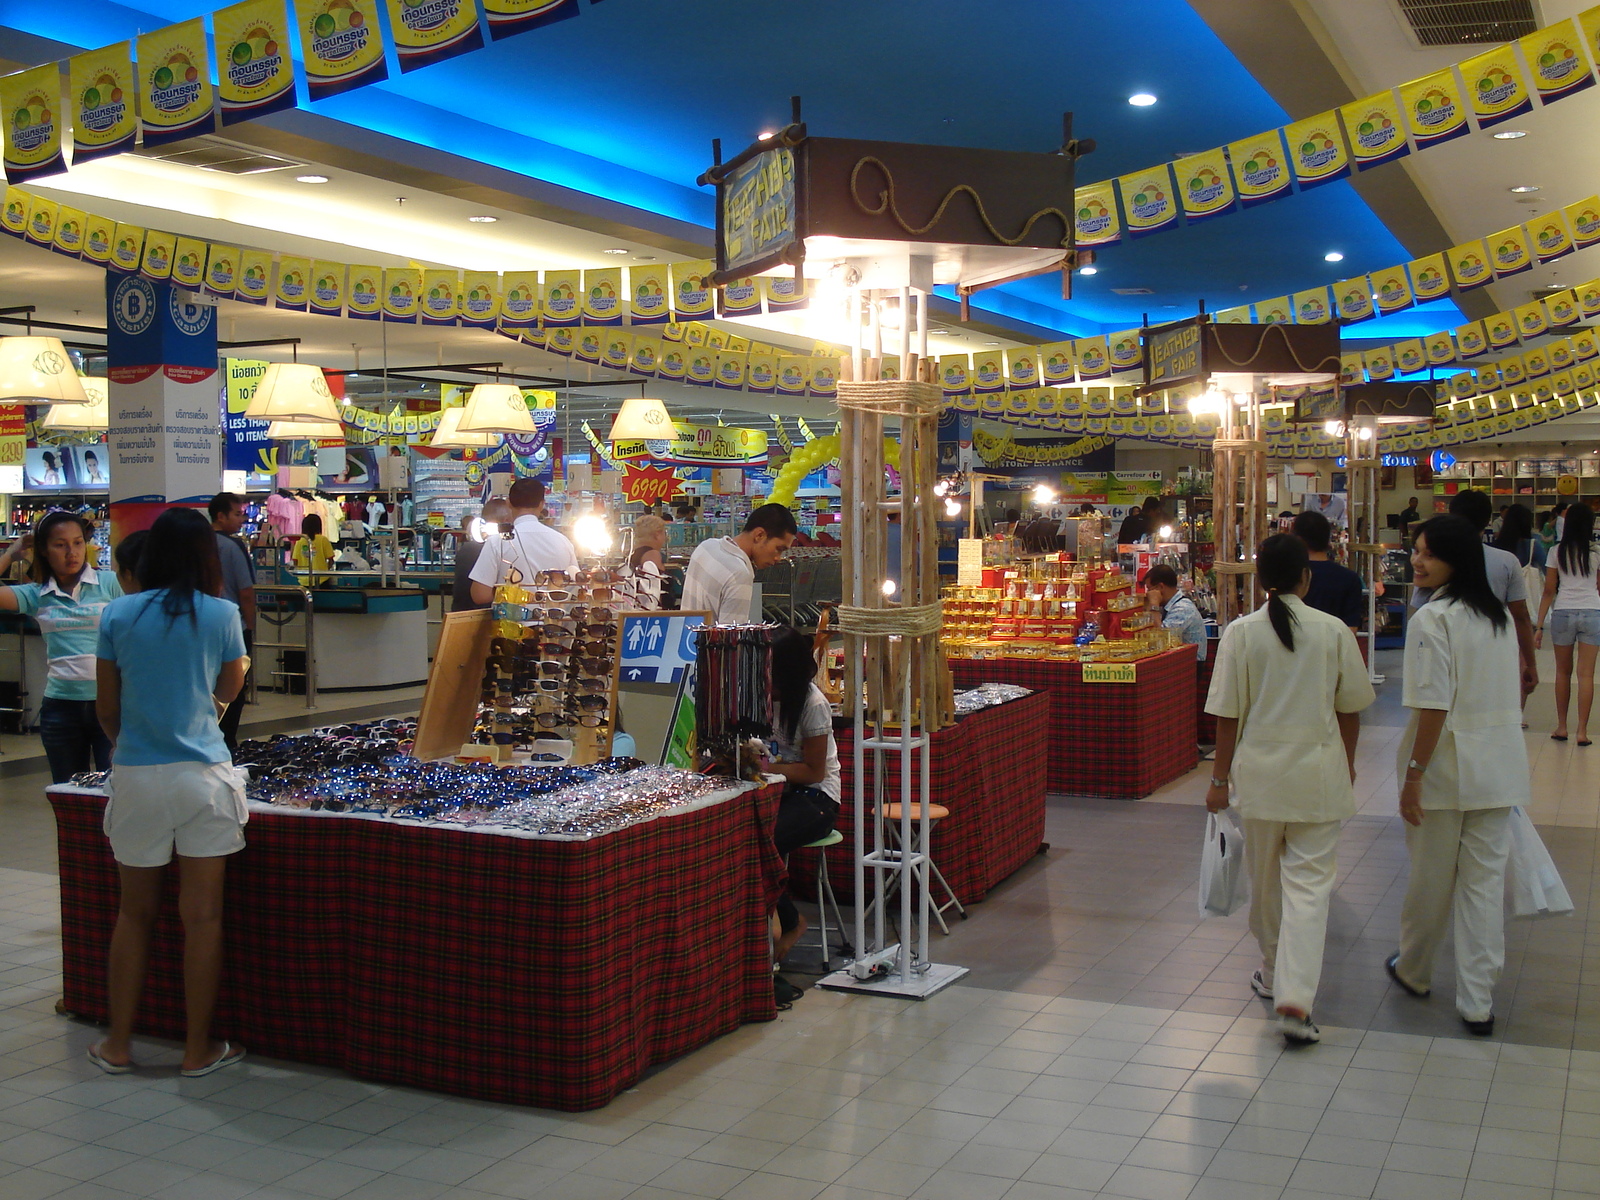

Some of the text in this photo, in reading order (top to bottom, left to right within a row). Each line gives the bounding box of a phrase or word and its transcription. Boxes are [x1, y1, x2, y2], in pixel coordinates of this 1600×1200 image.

[751, 204, 788, 253] FAIR
[116, 310, 152, 331] Cashier
[173, 308, 208, 332] Cashier
[1149, 326, 1199, 380] LEATHER
[1171, 350, 1197, 375] FAIR
[232, 363, 266, 379] น้อยกว่า
[239, 388, 249, 400] 10
[229, 418, 246, 429] LESS
[235, 430, 269, 442] 10 ITEMS
[697, 428, 712, 446] ถูก
[712, 434, 736, 457] ล้าน
[631, 478, 668, 498] 6990
